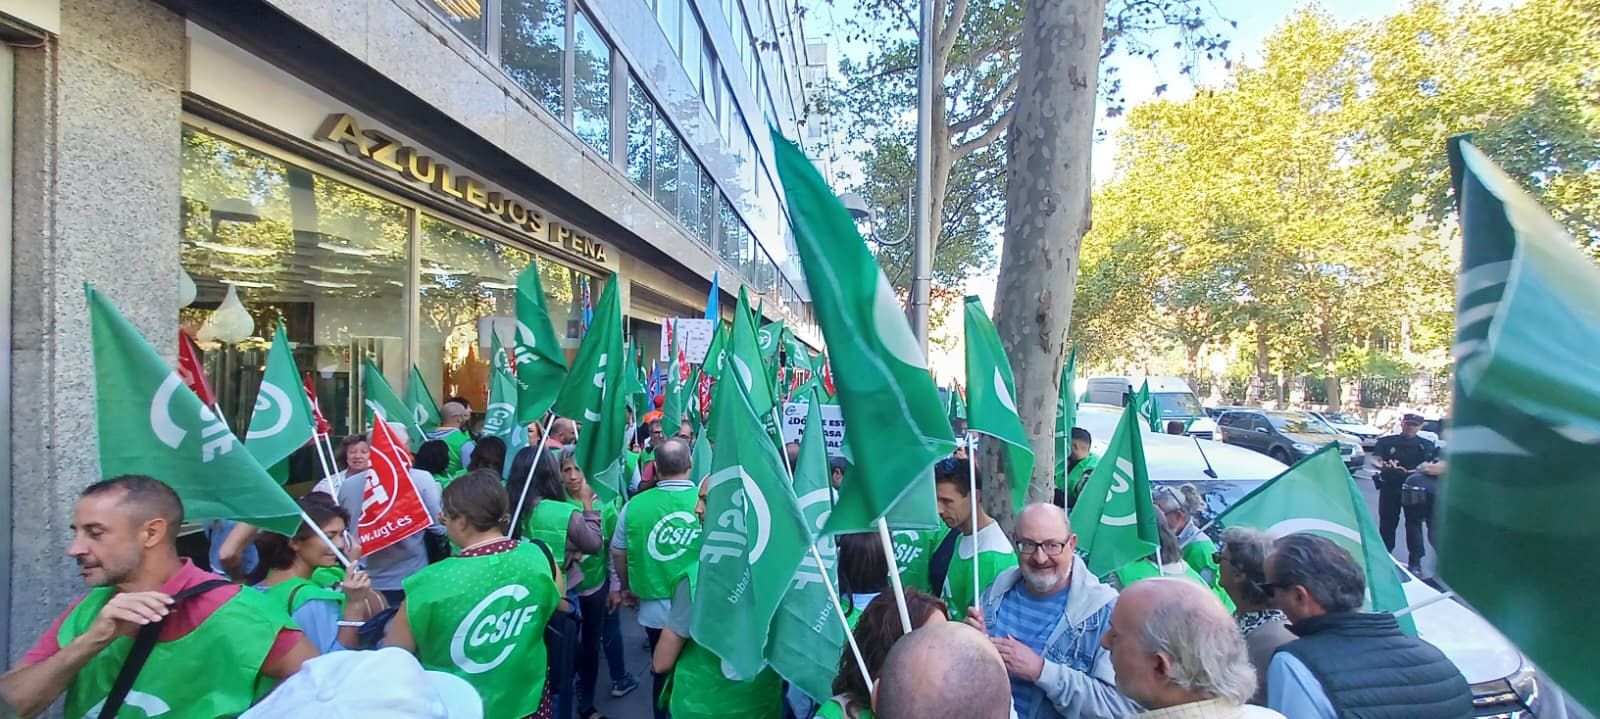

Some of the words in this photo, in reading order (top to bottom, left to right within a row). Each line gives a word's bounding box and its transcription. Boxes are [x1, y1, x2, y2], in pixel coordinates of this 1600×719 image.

[314, 113, 546, 234] AZULEJOS
[360, 515, 412, 543] w.ugt.es
[657, 525, 702, 546] CSIF
[469, 604, 538, 647] CSIF
